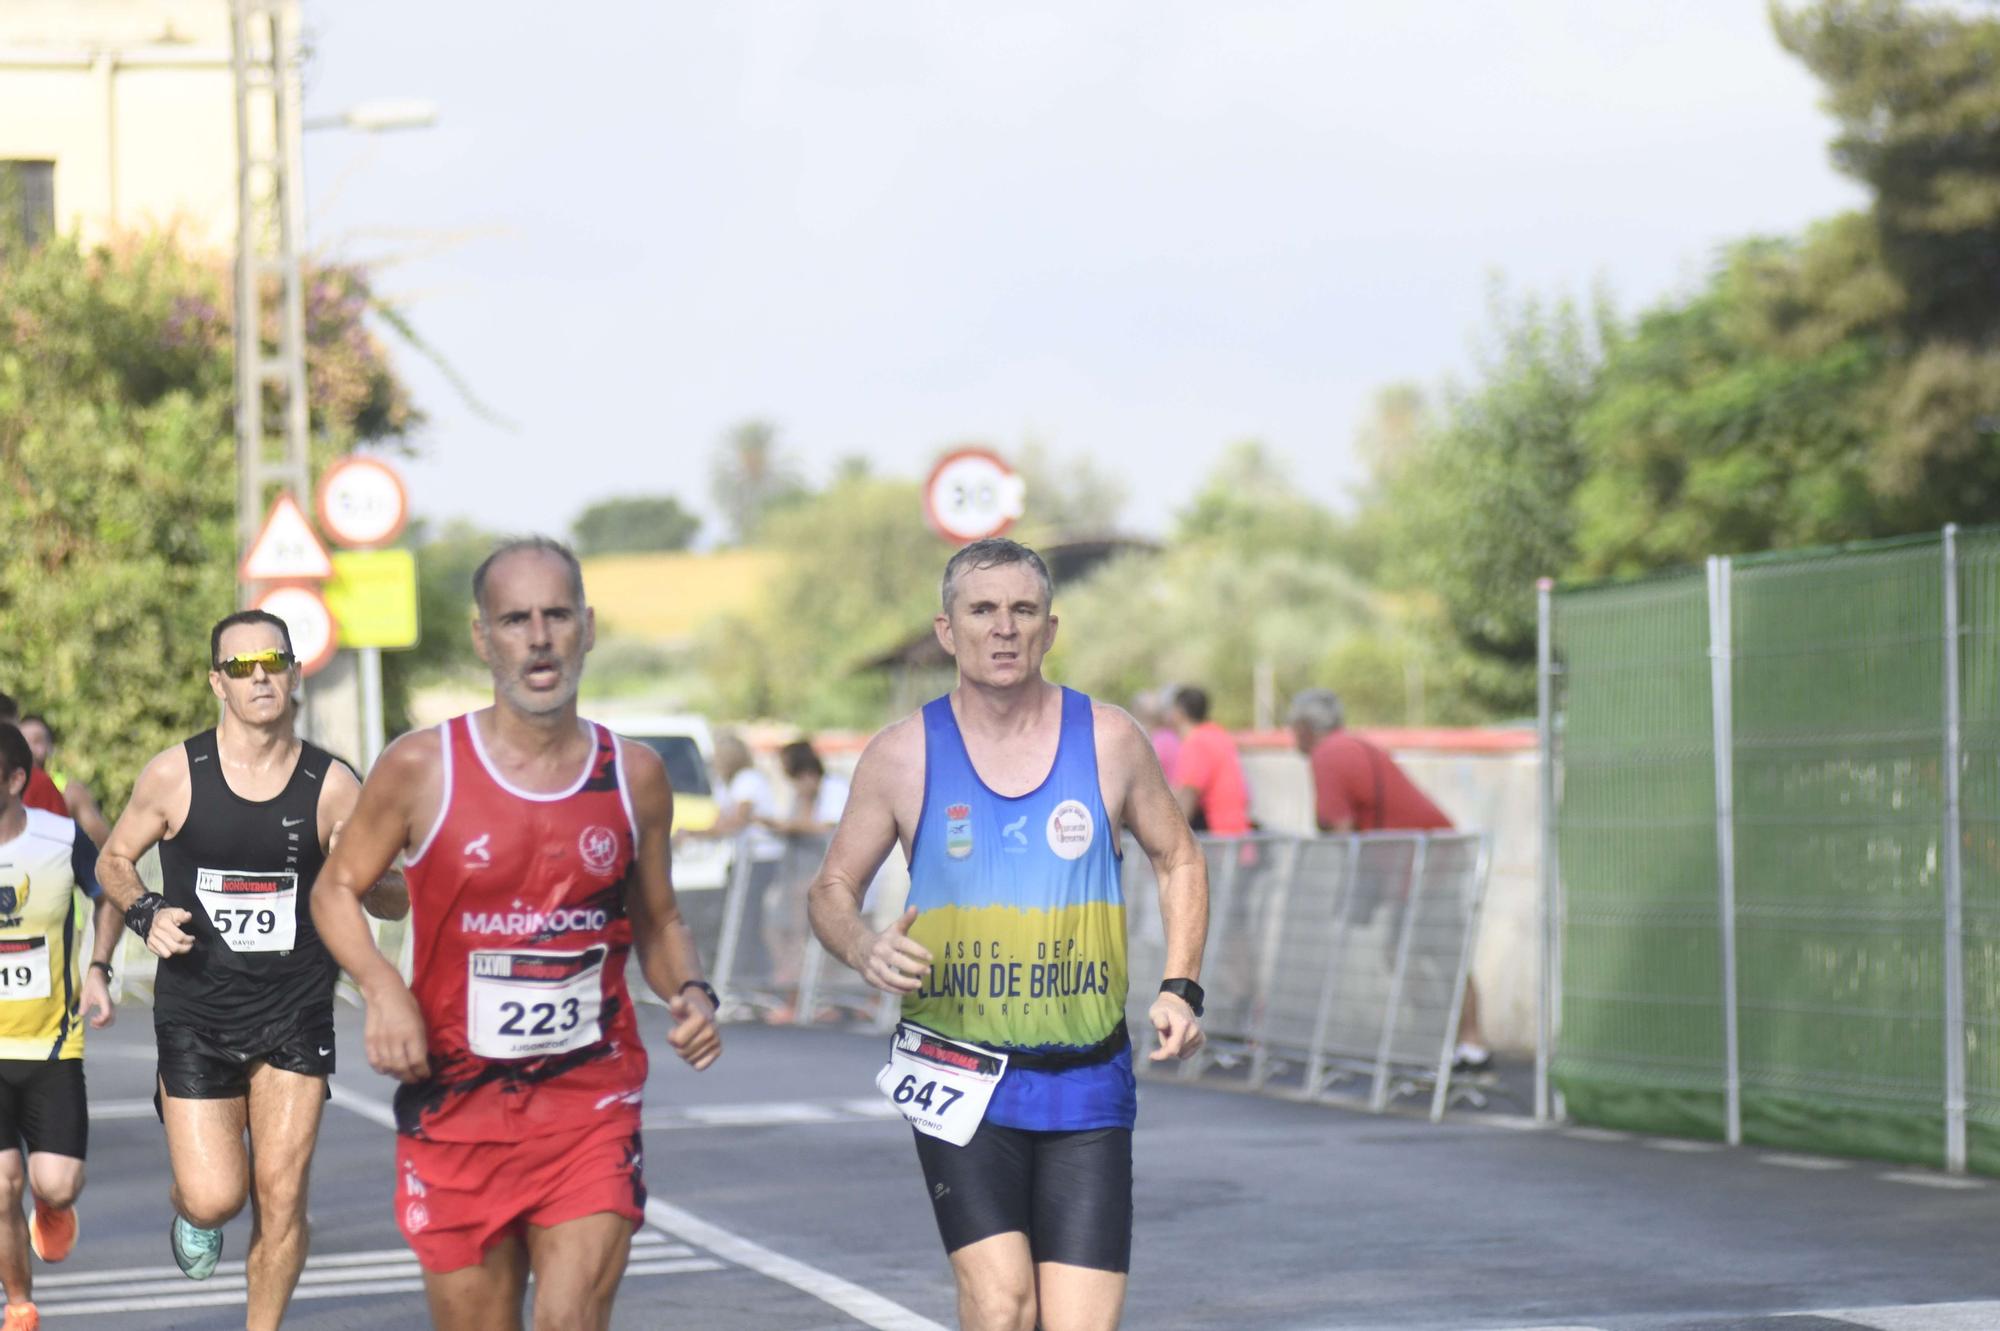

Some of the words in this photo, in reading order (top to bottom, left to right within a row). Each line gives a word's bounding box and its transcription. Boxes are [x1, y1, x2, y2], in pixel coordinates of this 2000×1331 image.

[213, 909, 276, 934] 579
[232, 939, 256, 947] DAVID
[944, 939, 1015, 960] ASOC.
[1037, 938, 1083, 960] DEP.
[989, 962, 1023, 999] DE
[1029, 960, 1110, 999] BRUJAS
[497, 997, 580, 1037] 223
[957, 1002, 1068, 1017] MURCIA
[893, 1074, 965, 1117] 647
[908, 1115, 943, 1131] ANTONIO
